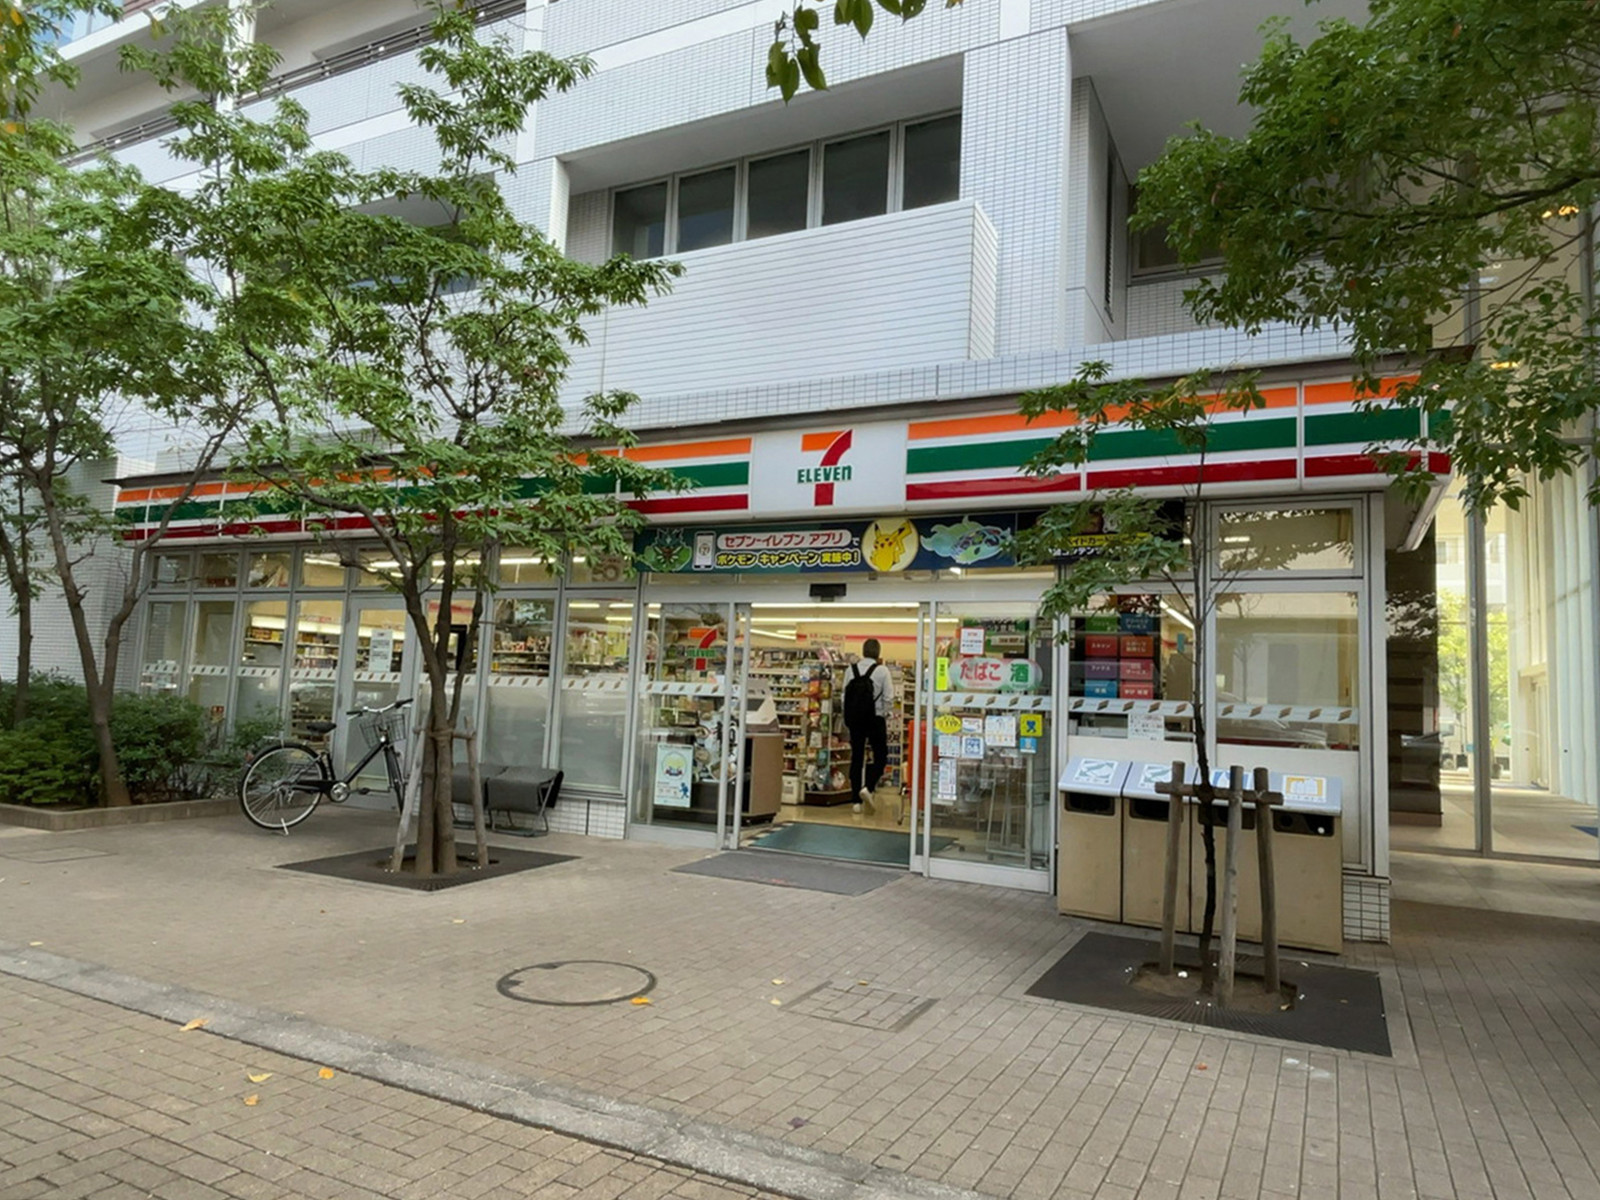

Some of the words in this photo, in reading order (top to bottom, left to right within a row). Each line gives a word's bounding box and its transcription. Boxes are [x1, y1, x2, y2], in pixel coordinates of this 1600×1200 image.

[801, 429, 852, 506] 7
[809, 532, 844, 546] アプリ
[716, 552, 757, 566] ポケモン
[760, 551, 818, 566] キャンペーン
[959, 660, 1002, 682] たばこ
[1010, 662, 1030, 683] 酒
